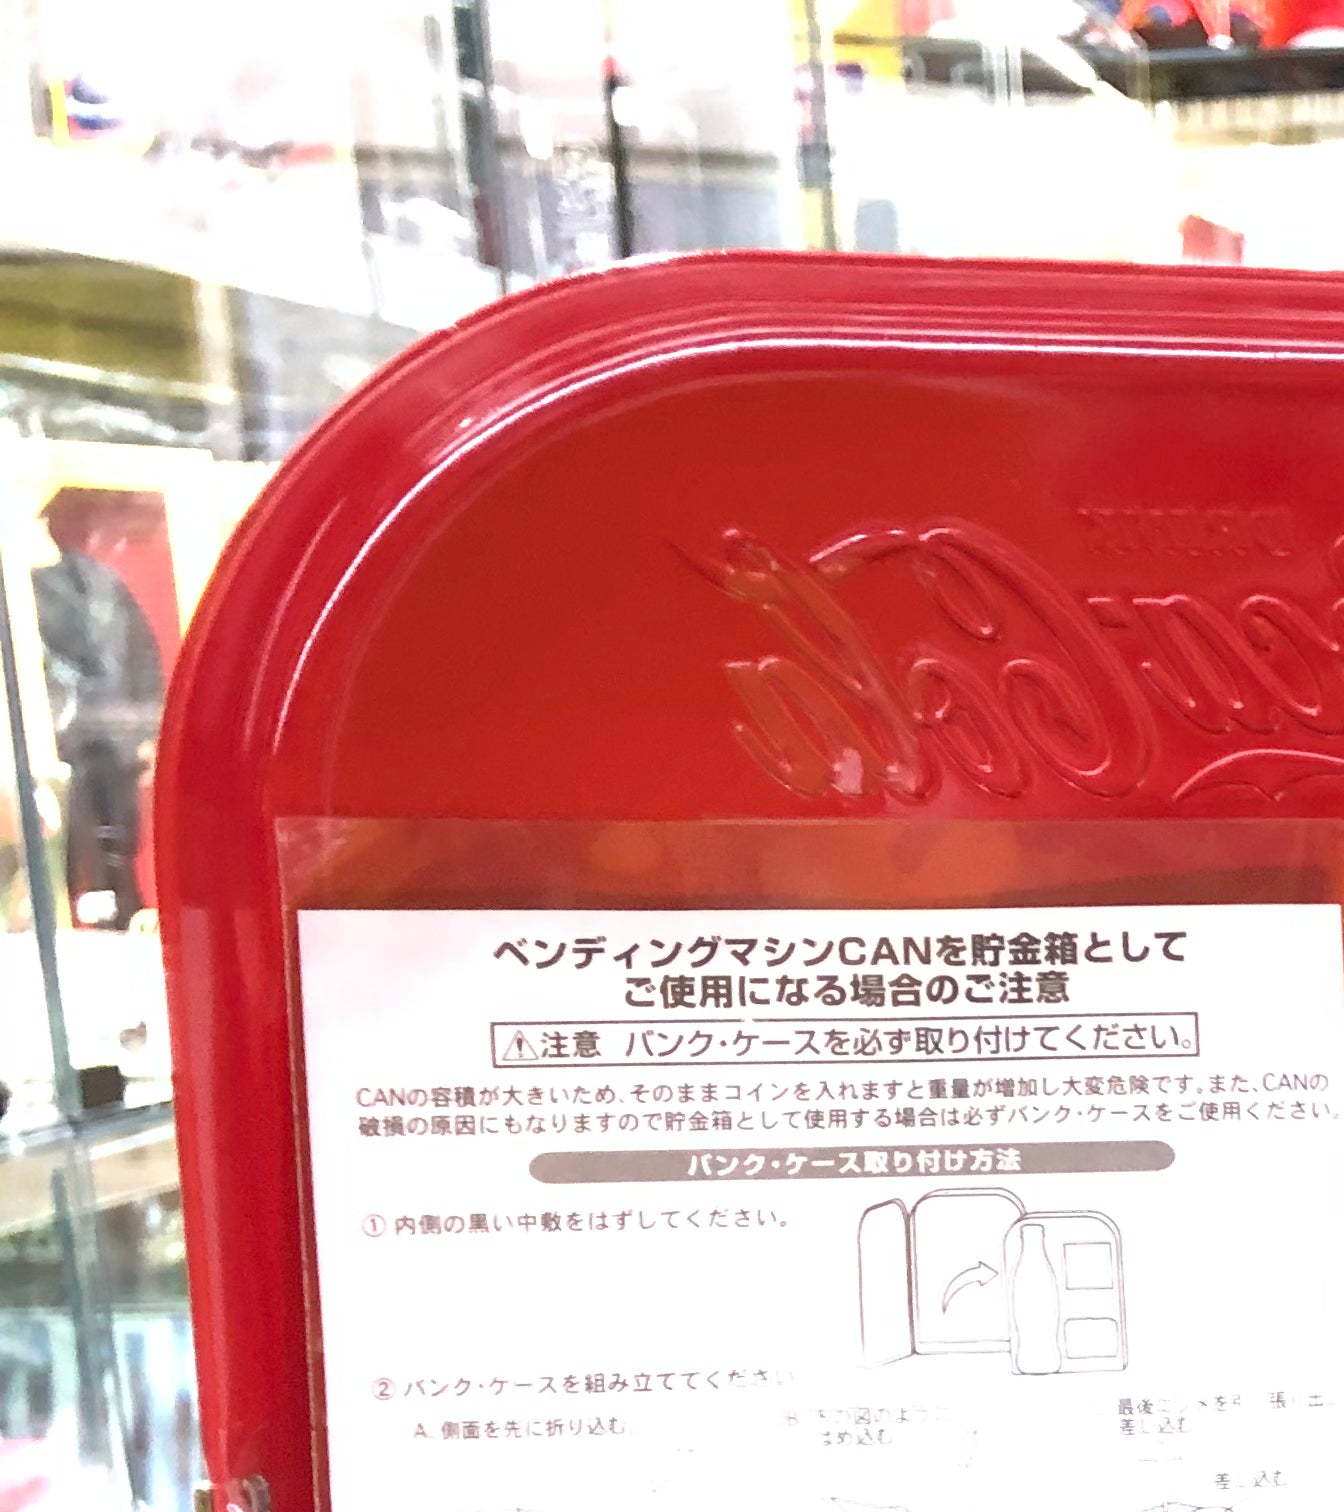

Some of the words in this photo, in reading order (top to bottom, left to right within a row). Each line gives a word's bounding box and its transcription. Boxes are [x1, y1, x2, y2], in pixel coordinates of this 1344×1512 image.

[493, 931, 1188, 970] ベンディングマシンCANを貯金箱として
[625, 971, 1070, 1009] ご使用になる場合のご注意
[541, 1030, 602, 1059] 注意
[626, 1023, 1192, 1059] バンク・ケースを必ず取り付けてください。
[689, 1148, 1021, 1178] バンク・ケース取り付け方法
